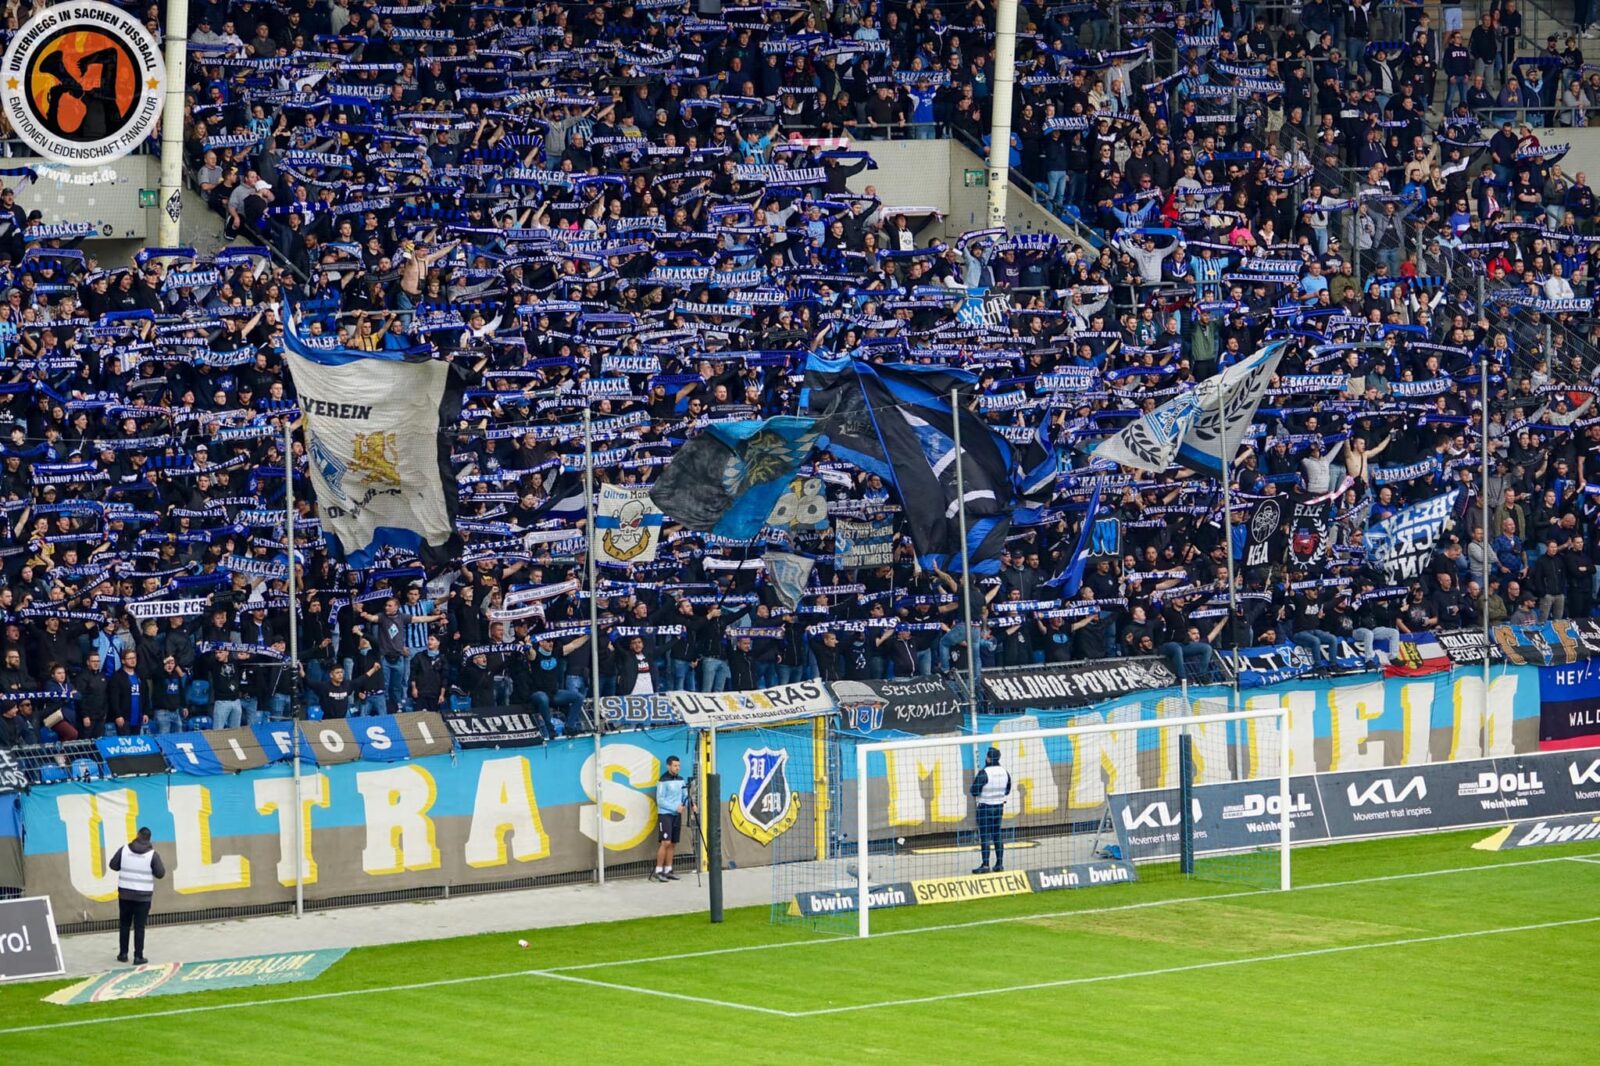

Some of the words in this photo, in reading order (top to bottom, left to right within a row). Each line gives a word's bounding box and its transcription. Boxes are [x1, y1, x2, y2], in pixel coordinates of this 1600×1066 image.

[1219, 65, 1260, 76] BARACKLER
[336, 85, 386, 96] BARACKLER
[512, 90, 555, 103] BARACKLER
[514, 168, 564, 180] BARACKLER
[32, 222, 88, 237] BARACKLER
[656, 266, 710, 281] BARACKLER
[716, 269, 760, 283] BARACKLER
[736, 292, 784, 302] BARACKLER
[686, 302, 741, 316] BARACKLER
[1044, 376, 1092, 387] BARACKLER
[1290, 376, 1343, 387] BARACKLER
[1399, 381, 1445, 395] BARACKLER
[222, 427, 274, 439] BARACKLER
[1385, 460, 1431, 479] BARACKLER
[604, 491, 628, 499] Ultras
[851, 543, 894, 556] WALDHOF
[228, 556, 285, 575] BARACKLER
[129, 601, 180, 617] SCHEISS
[1048, 607, 1090, 618] KURPFALZ
[535, 627, 585, 641] KURPFALZ
[1439, 633, 1486, 649] KOLLEKTI
[880, 680, 946, 697] SEKTION
[894, 700, 961, 721] KROMILA
[446, 713, 537, 735] RAPHI
[1478, 772, 1543, 795] DOLL
[1480, 797, 1529, 811] Weinheim
[1353, 809, 1390, 822] Movement
[1391, 808, 1405, 818] that
[1406, 806, 1432, 818] inspires
[1128, 835, 1166, 846] Movement
[1039, 868, 1080, 888] bwin
[1087, 864, 1129, 883] bwin
[917, 873, 1027, 901] SPORTWETTEN
[811, 891, 853, 913] bwin
[182, 953, 317, 982] EICHBAUM
